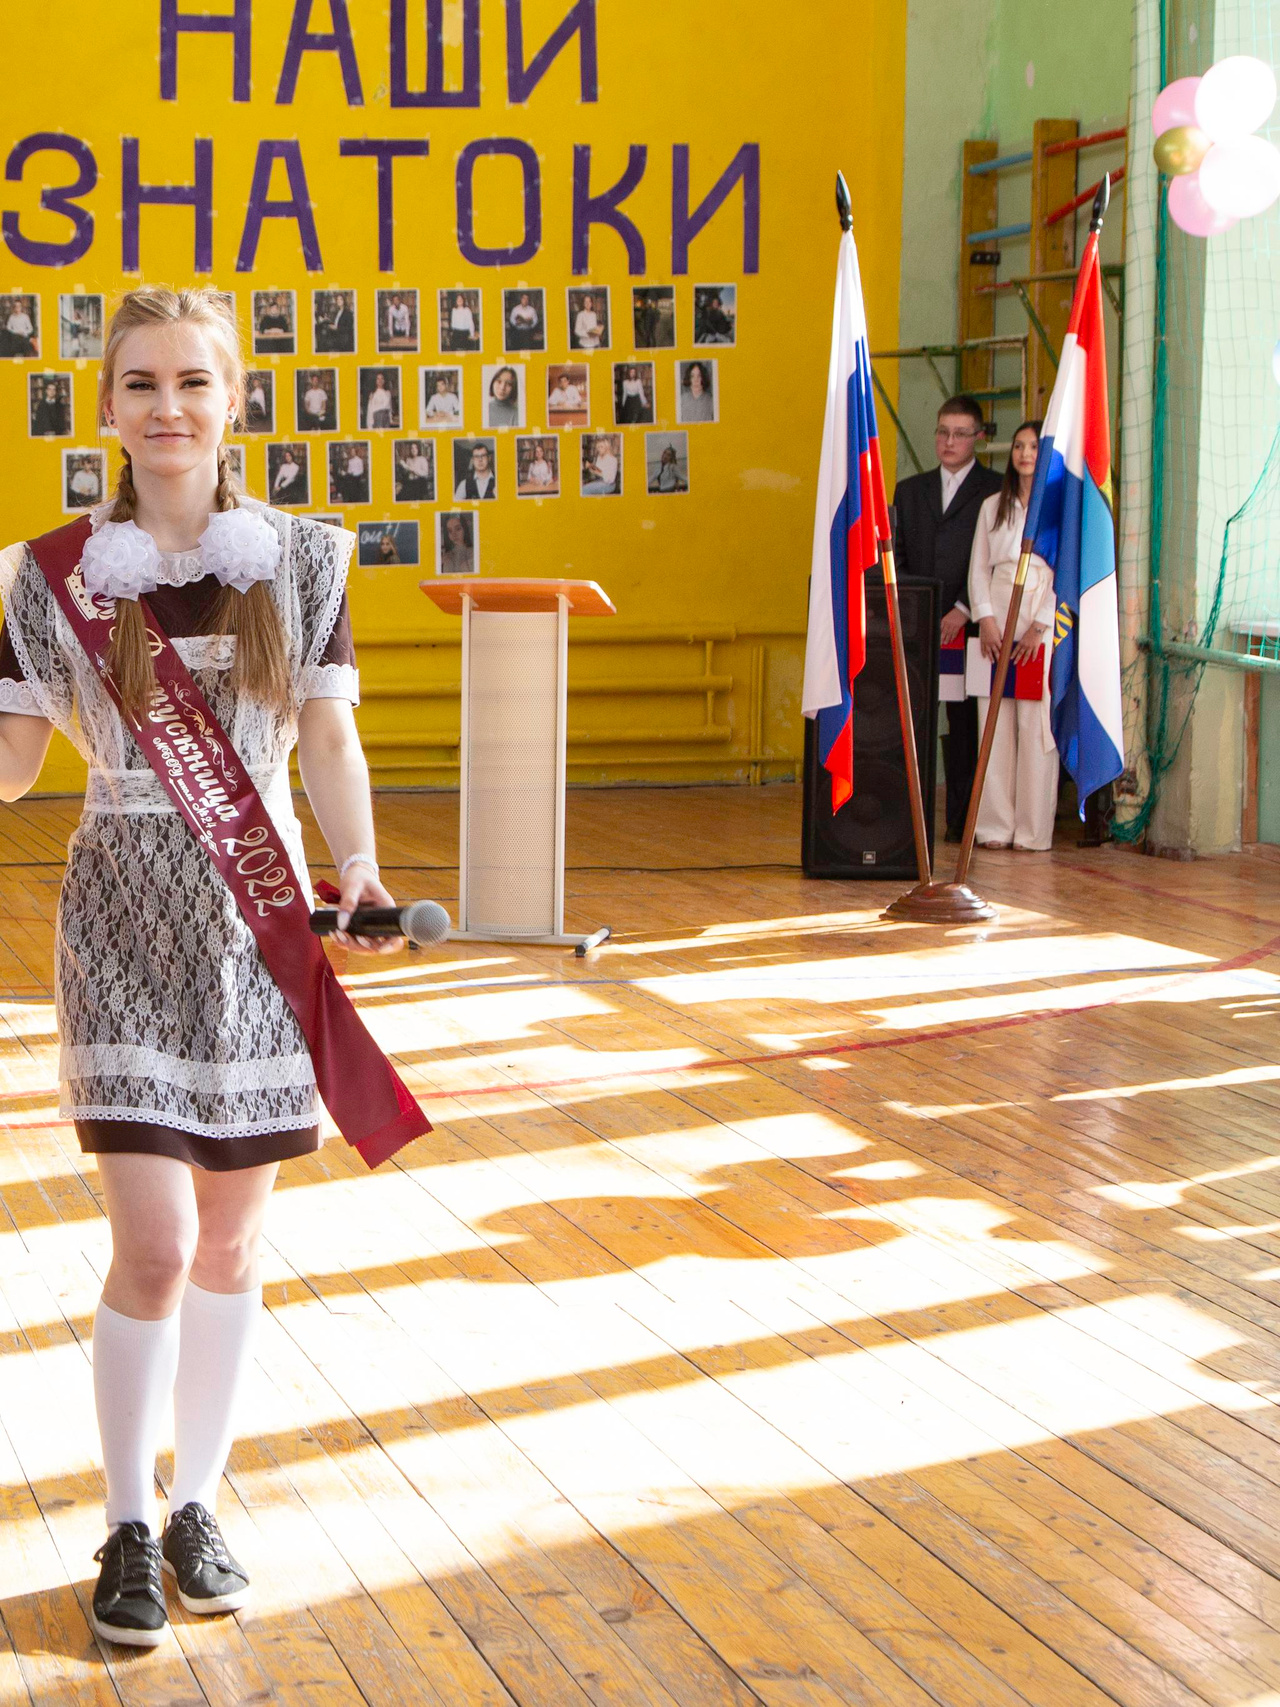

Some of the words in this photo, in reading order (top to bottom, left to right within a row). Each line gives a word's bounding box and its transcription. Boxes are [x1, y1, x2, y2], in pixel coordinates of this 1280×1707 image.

[160, 0, 598, 108] НАШИ
[1, 132, 760, 275] ЗНАТОКИ
[152, 736, 185, 778] МБОУ
[176, 778, 195, 802] школа
[192, 801, 218, 829] №24
[221, 826, 296, 917] 2022
